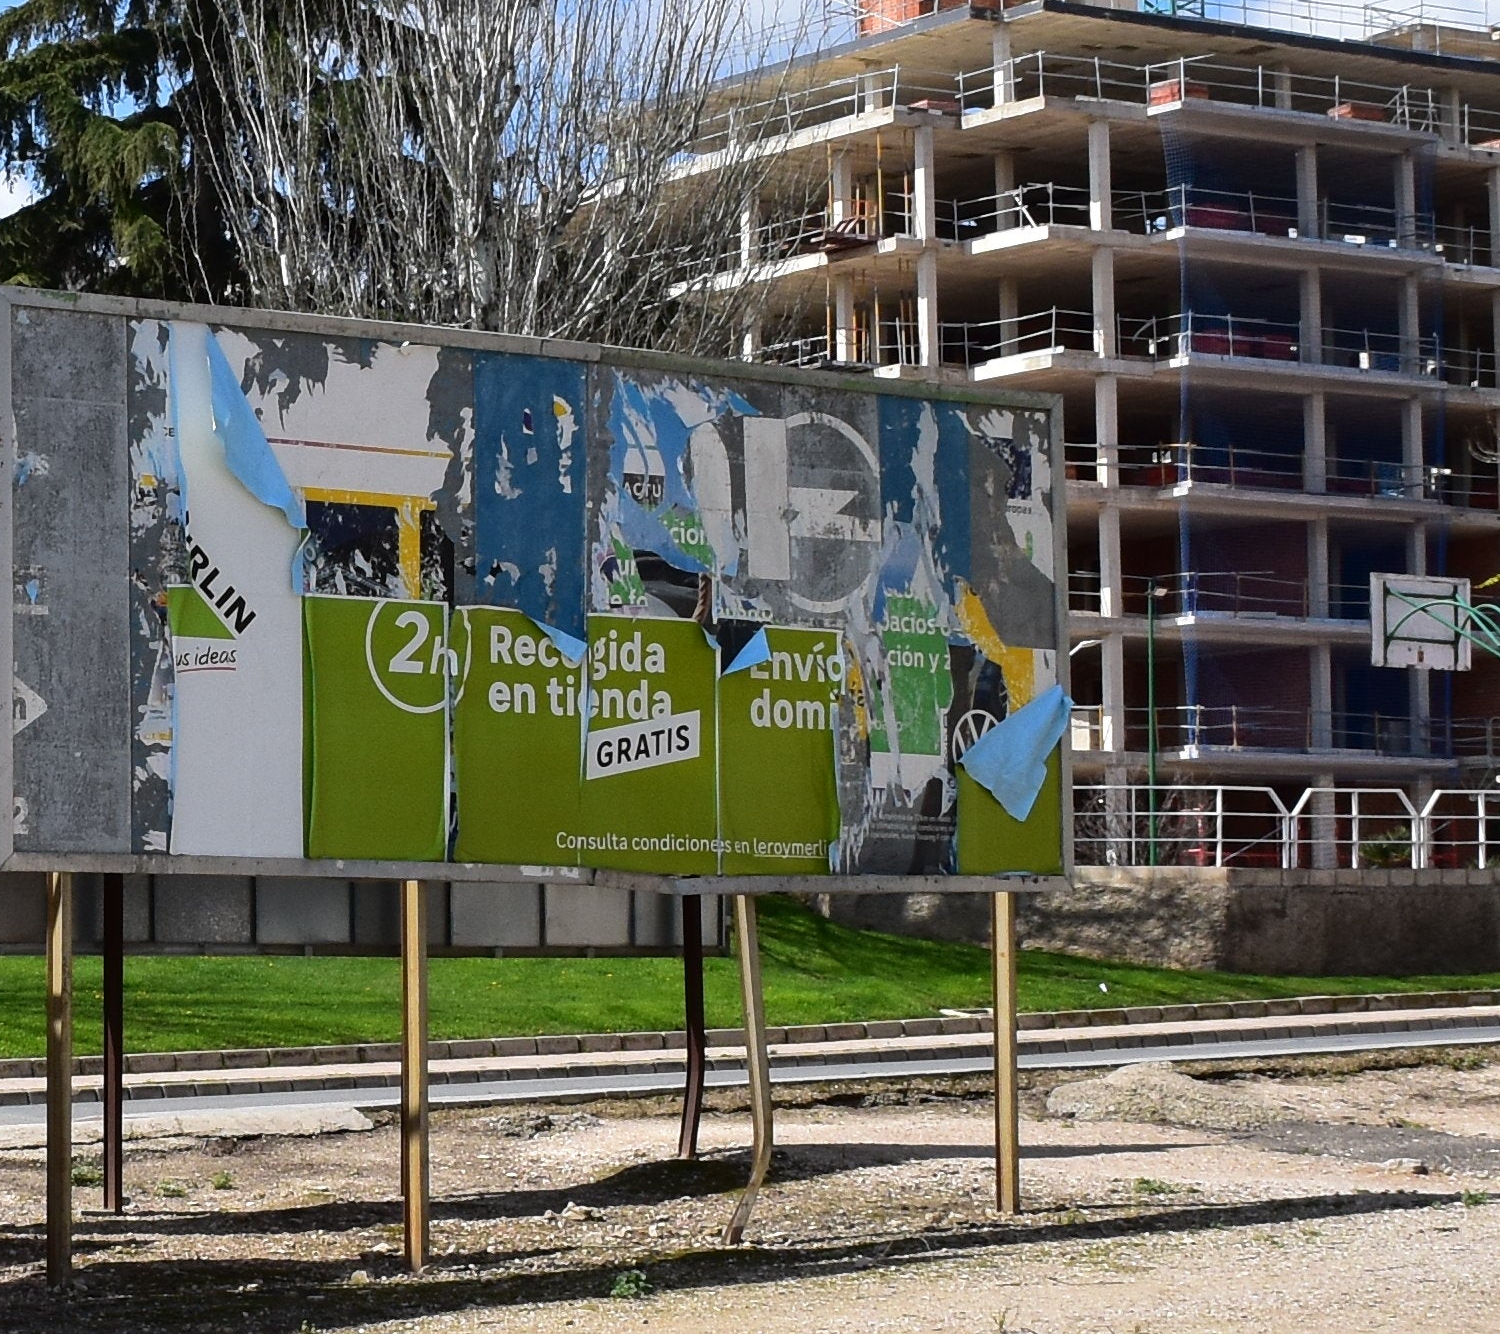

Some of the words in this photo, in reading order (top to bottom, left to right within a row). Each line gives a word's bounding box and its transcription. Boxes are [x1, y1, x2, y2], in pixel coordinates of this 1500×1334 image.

[185, 535, 257, 634] RLIN
[194, 646, 237, 667] ideas
[388, 610, 459, 677] 2h
[928, 652, 940, 674] y
[488, 680, 537, 714] en
[546, 673, 672, 720] tienda
[596, 724, 691, 768] GRATIS
[556, 831, 629, 852] Consulta
[631, 834, 732, 855] condiciones
[734, 838, 750, 854] en
